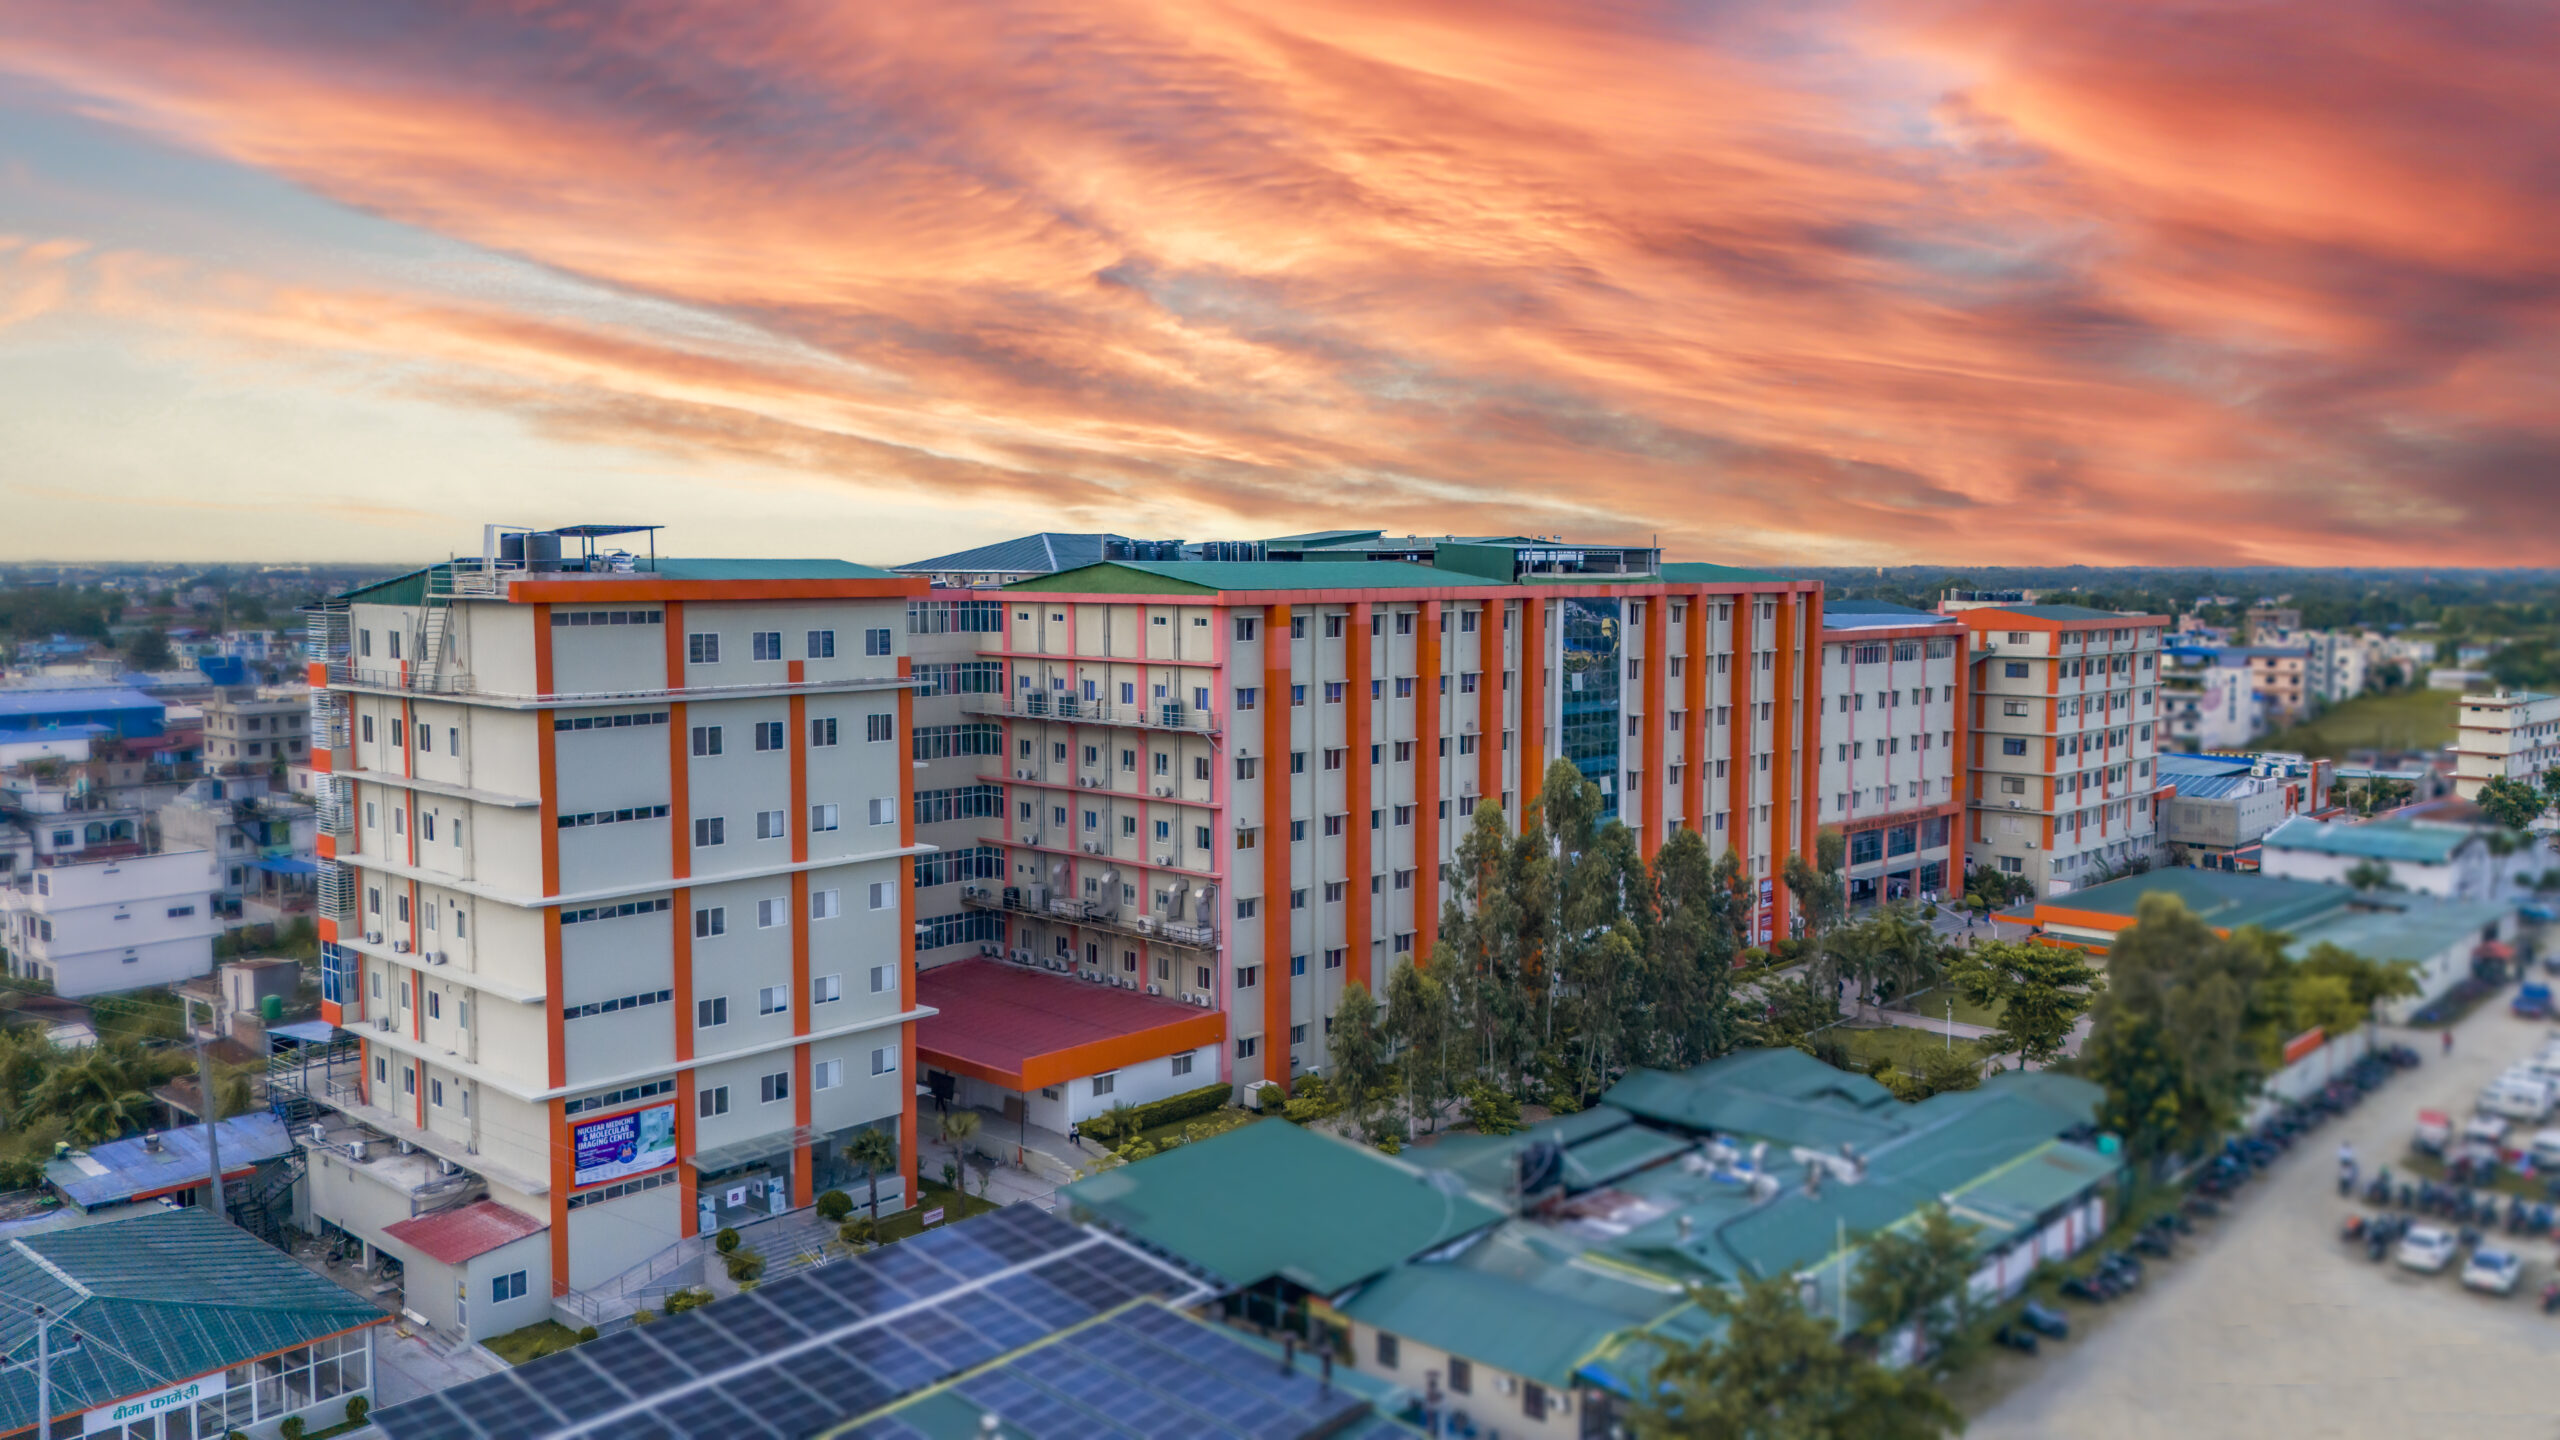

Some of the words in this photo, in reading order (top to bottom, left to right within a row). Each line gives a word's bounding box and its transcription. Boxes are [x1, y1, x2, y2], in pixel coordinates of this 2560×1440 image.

[577, 1123, 605, 1136] NUCLEAR
[606, 1116, 634, 1129] MEDICINE
[582, 1134, 588, 1142] &
[589, 1125, 630, 1139] MOLECULAR
[577, 1137, 608, 1150] IMAGING
[609, 1131, 635, 1142] CENTER
[113, 1403, 144, 1420] बीमा
